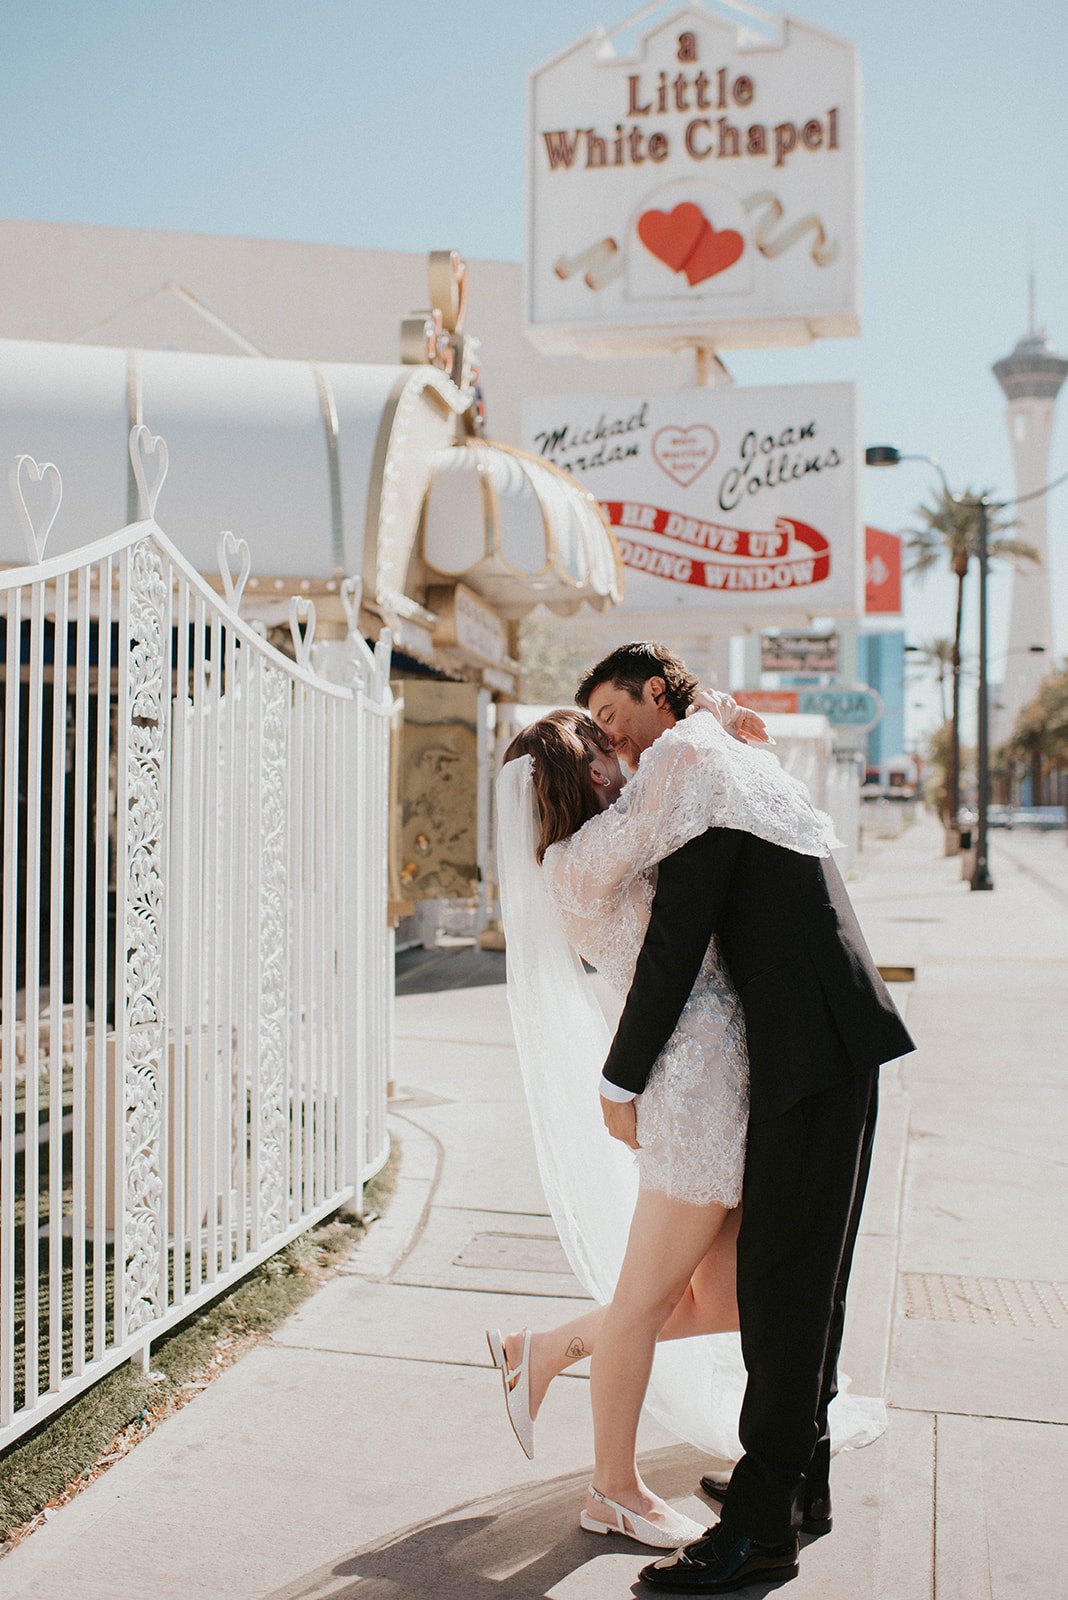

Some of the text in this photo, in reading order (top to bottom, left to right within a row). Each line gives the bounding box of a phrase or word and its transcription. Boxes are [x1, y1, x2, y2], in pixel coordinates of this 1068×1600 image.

[677, 31, 698, 62] a
[626, 68, 755, 117] Little
[542, 108, 840, 171] White Chapel
[534, 402, 648, 455] Michael
[740, 421, 815, 475] Joan
[549, 442, 639, 473] ordan
[718, 447, 842, 511] Collins
[621, 505, 657, 532] HR
[663, 513, 739, 554] DRIVE
[748, 532, 784, 556] UP
[617, 541, 815, 590] DDING WINDOW
